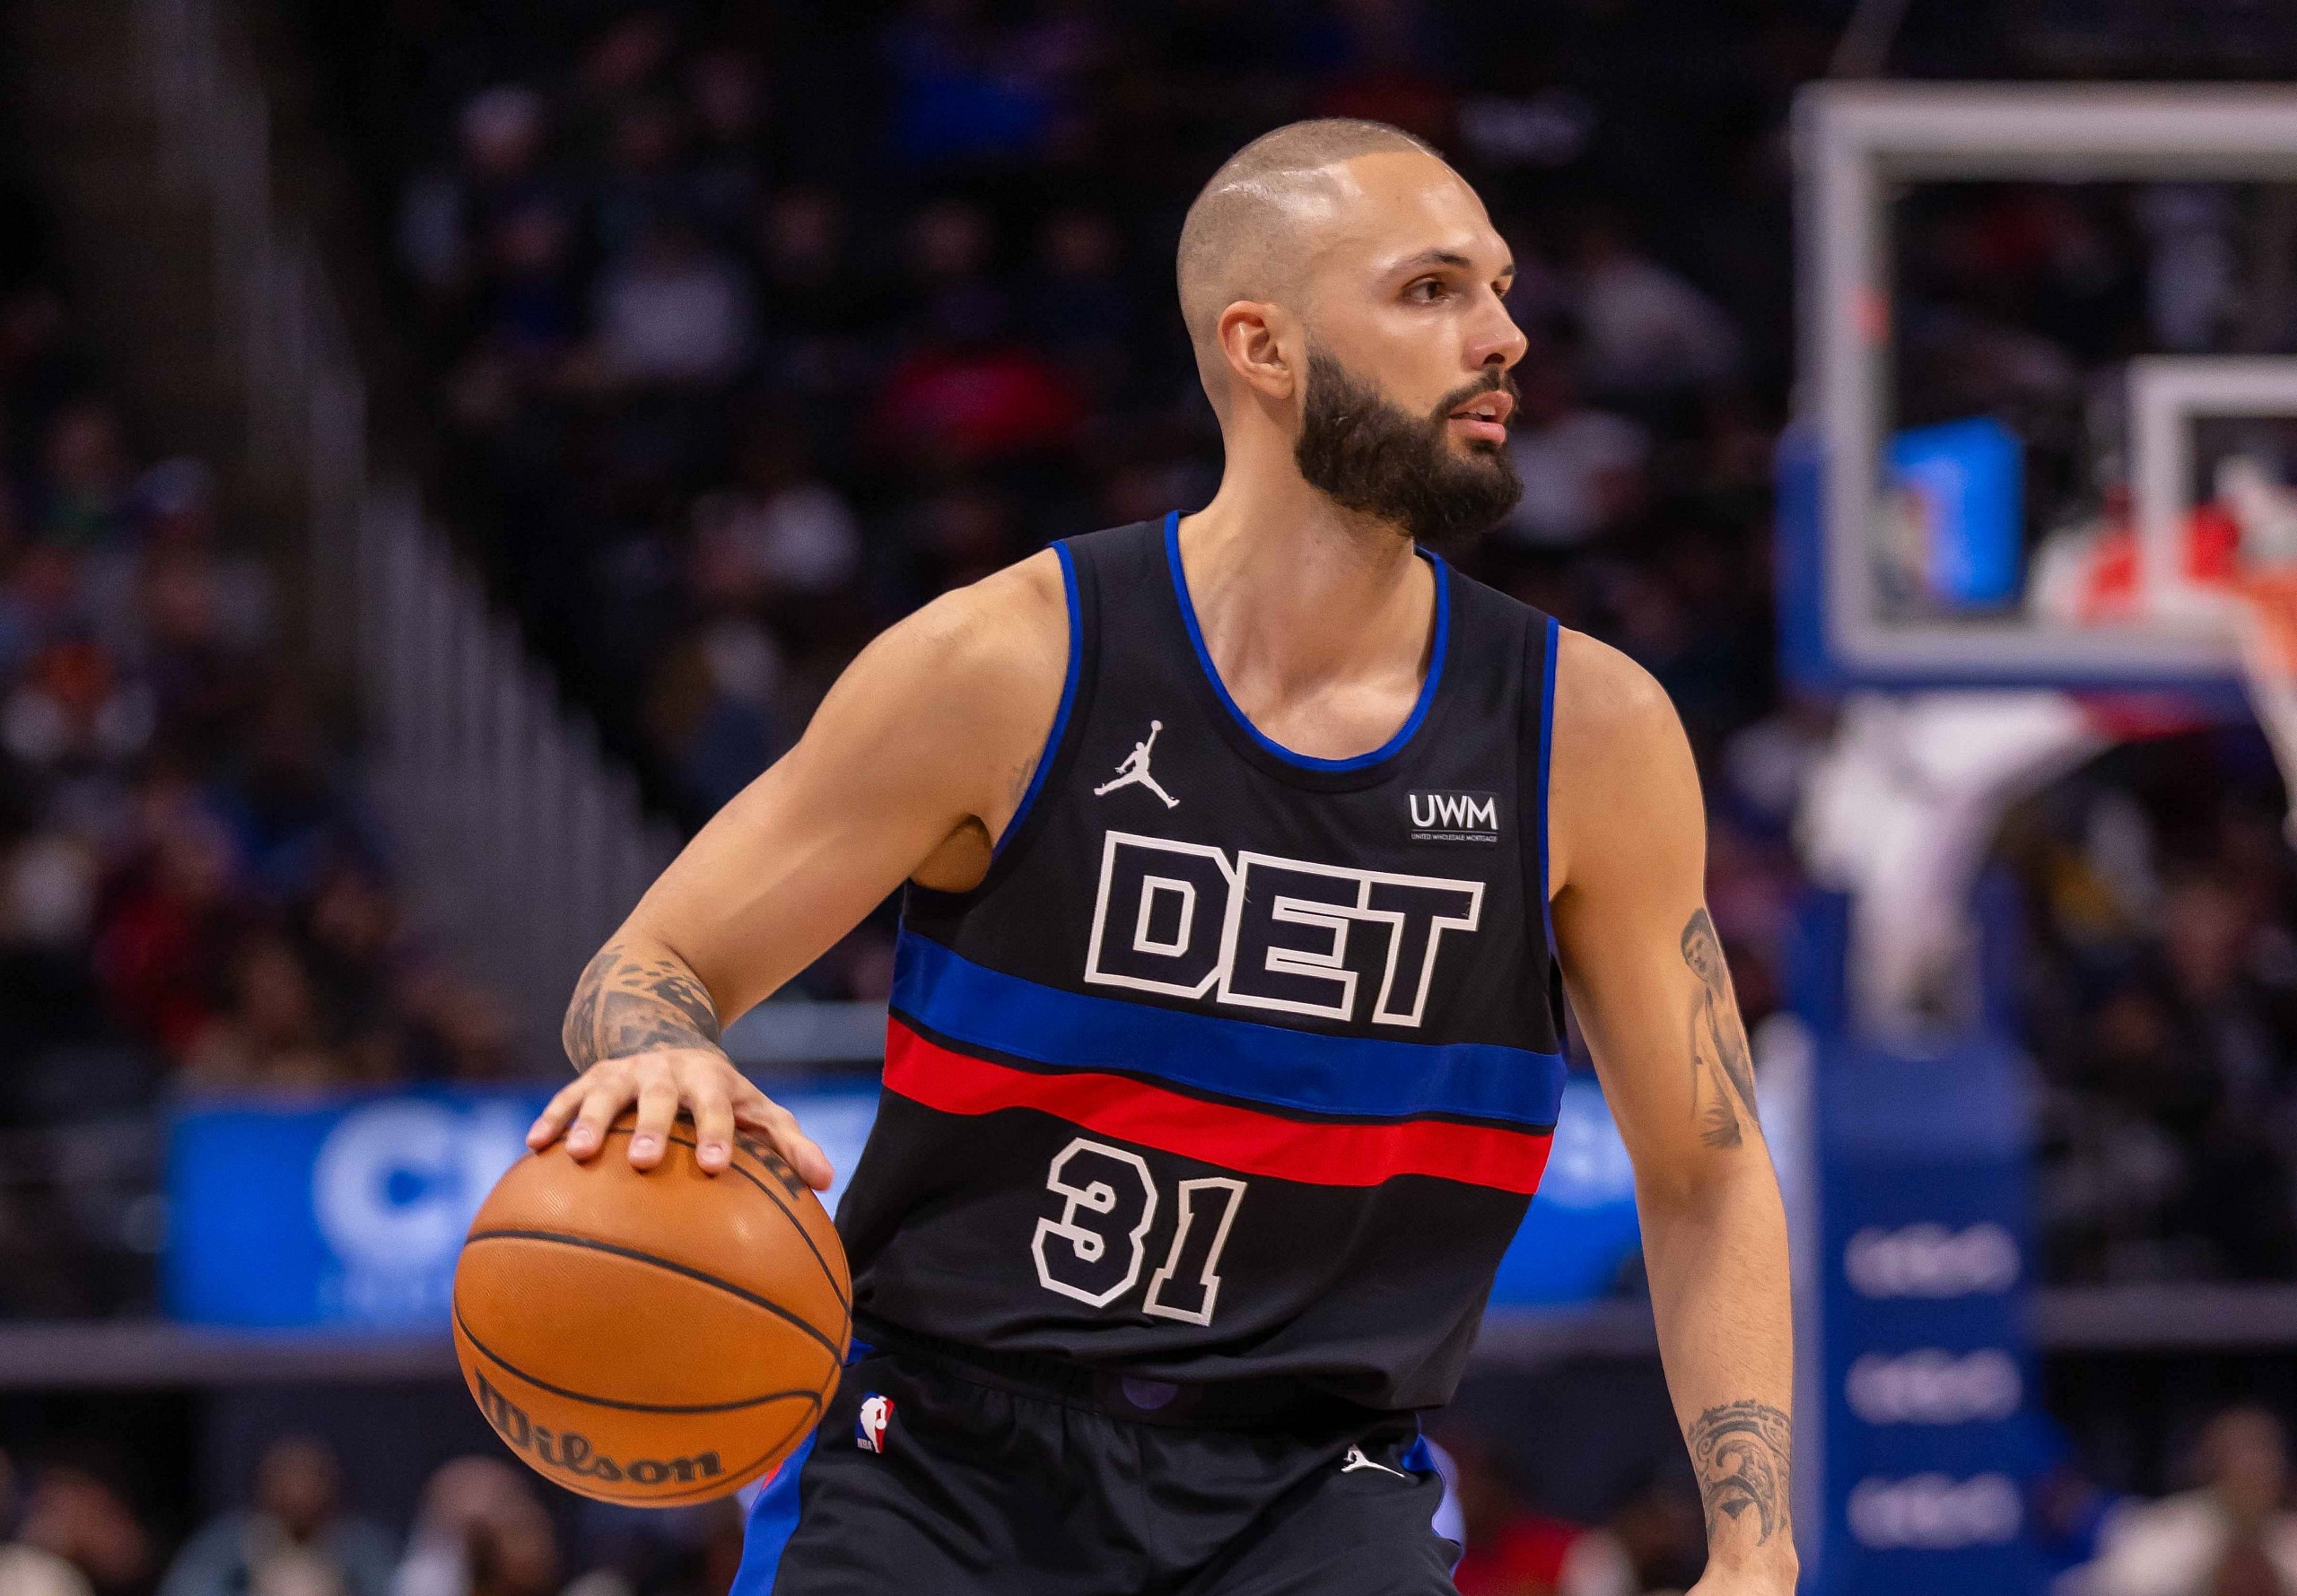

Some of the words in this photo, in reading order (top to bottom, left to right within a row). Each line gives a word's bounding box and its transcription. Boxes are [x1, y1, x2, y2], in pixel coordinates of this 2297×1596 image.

[1410, 794, 1498, 830] UWM
[1085, 830, 1485, 1028] DET
[1032, 1137, 1247, 1327] 31
[474, 1366, 725, 1485] Wilson
[857, 1437, 873, 1450] NBA
